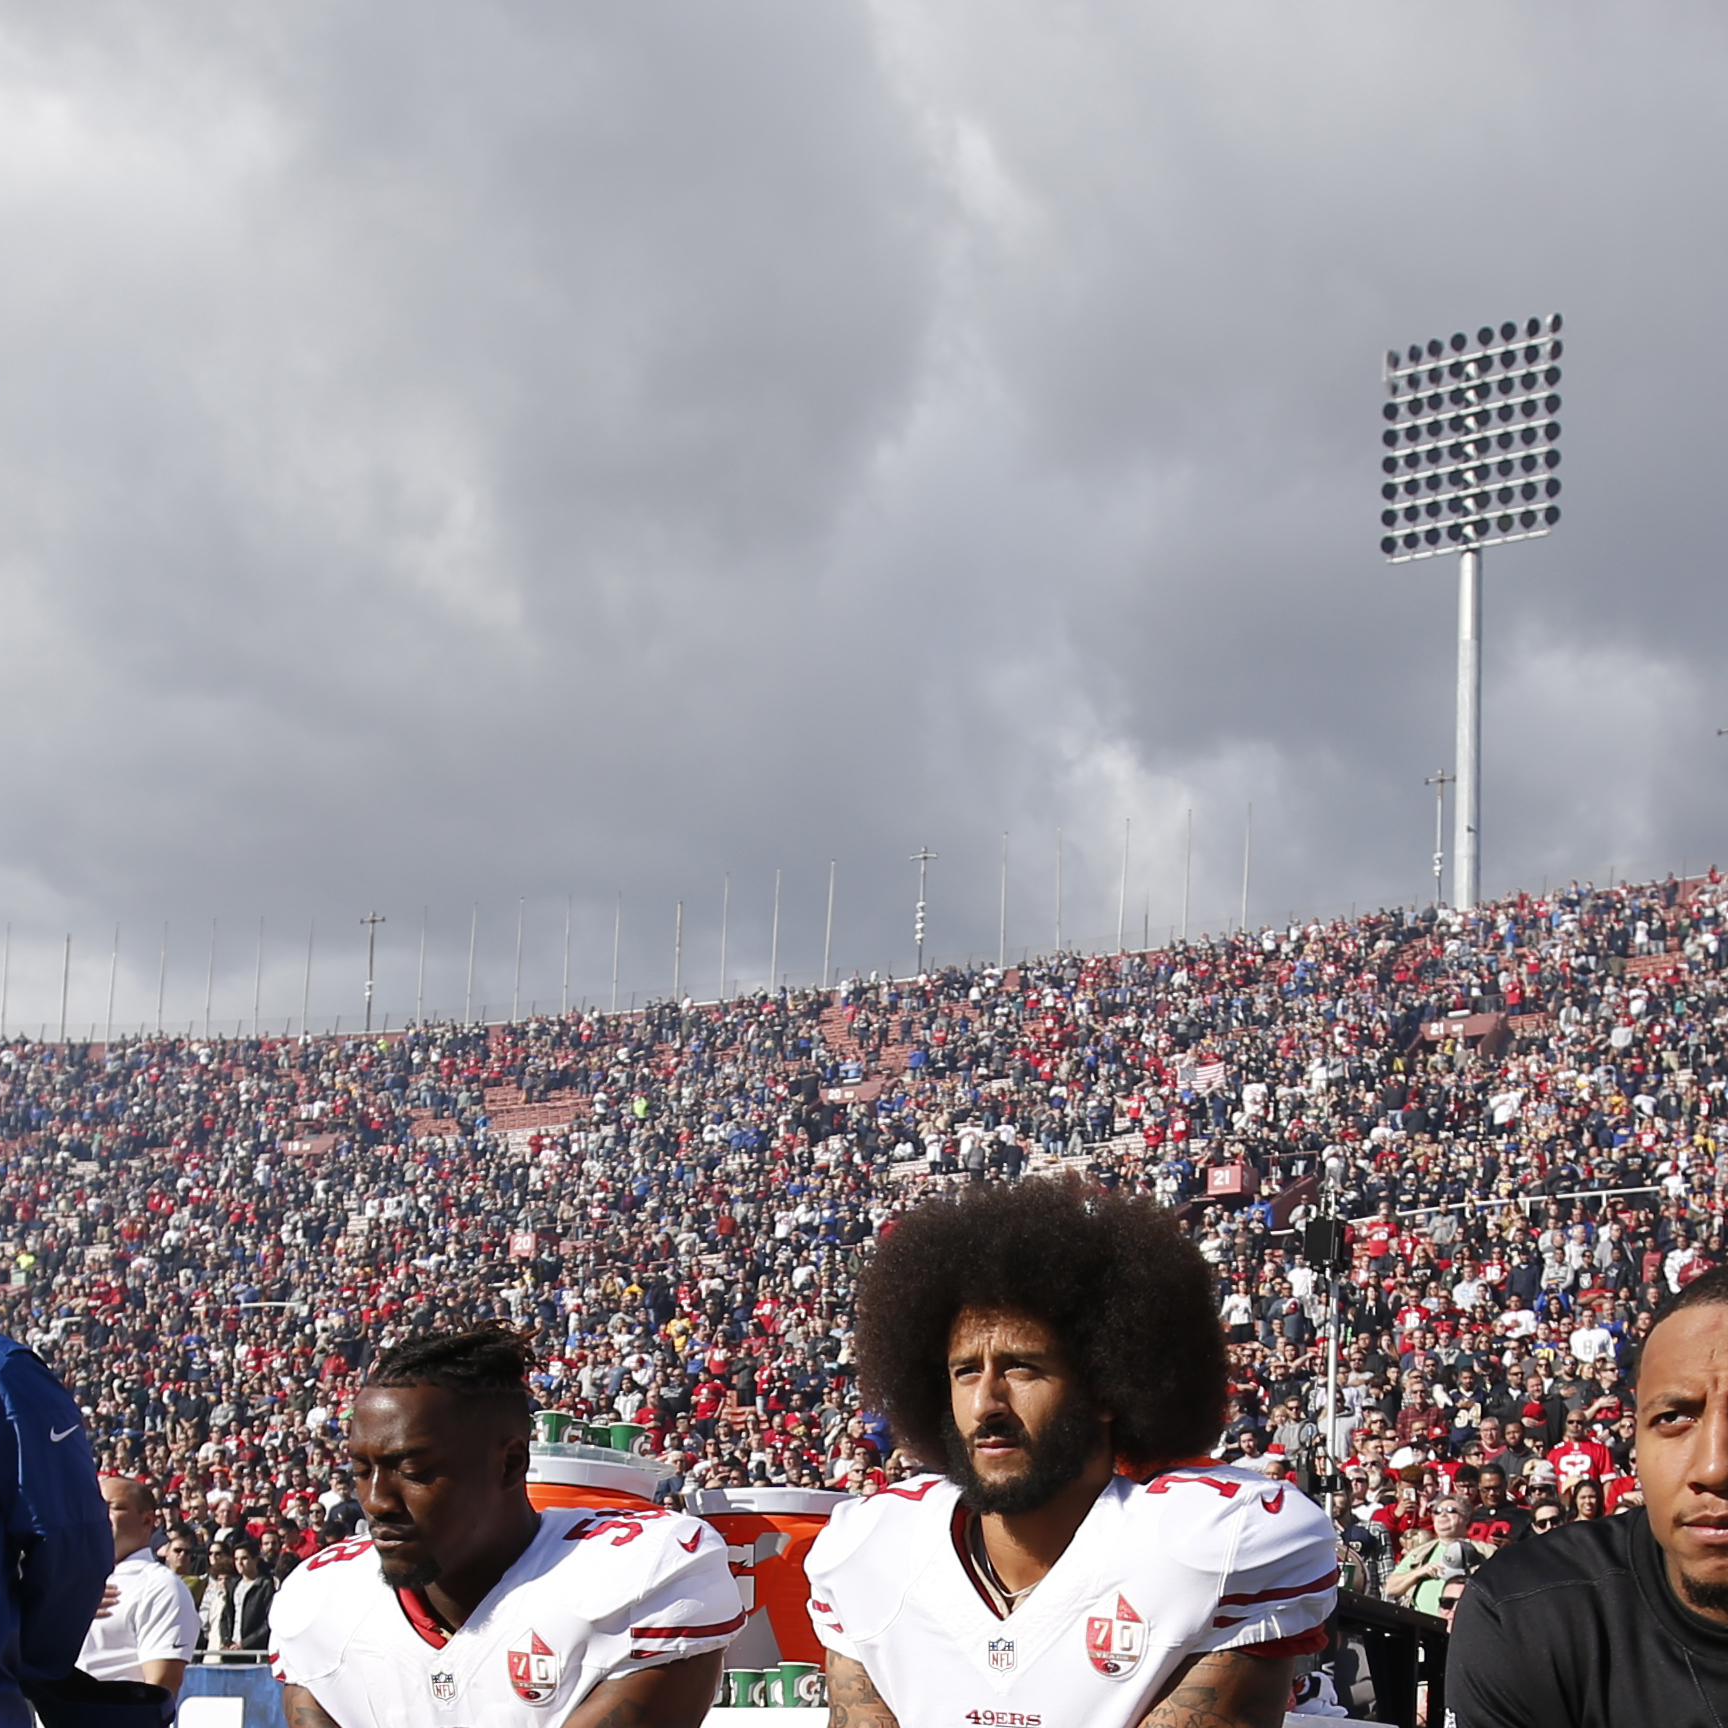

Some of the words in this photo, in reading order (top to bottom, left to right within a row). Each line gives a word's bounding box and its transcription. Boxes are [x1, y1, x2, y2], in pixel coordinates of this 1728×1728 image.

[1430, 1022, 1445, 1036] 21
[828, 1088, 843, 1100] 20
[1213, 1169, 1231, 1186] 21
[513, 1235, 533, 1251] 20
[1094, 1619, 1135, 1652] 70
[991, 1652, 1014, 1668] NFL
[514, 1656, 552, 1682] 70
[434, 1684, 455, 1698] NFL
[965, 1709, 1042, 1728] 49ERS
